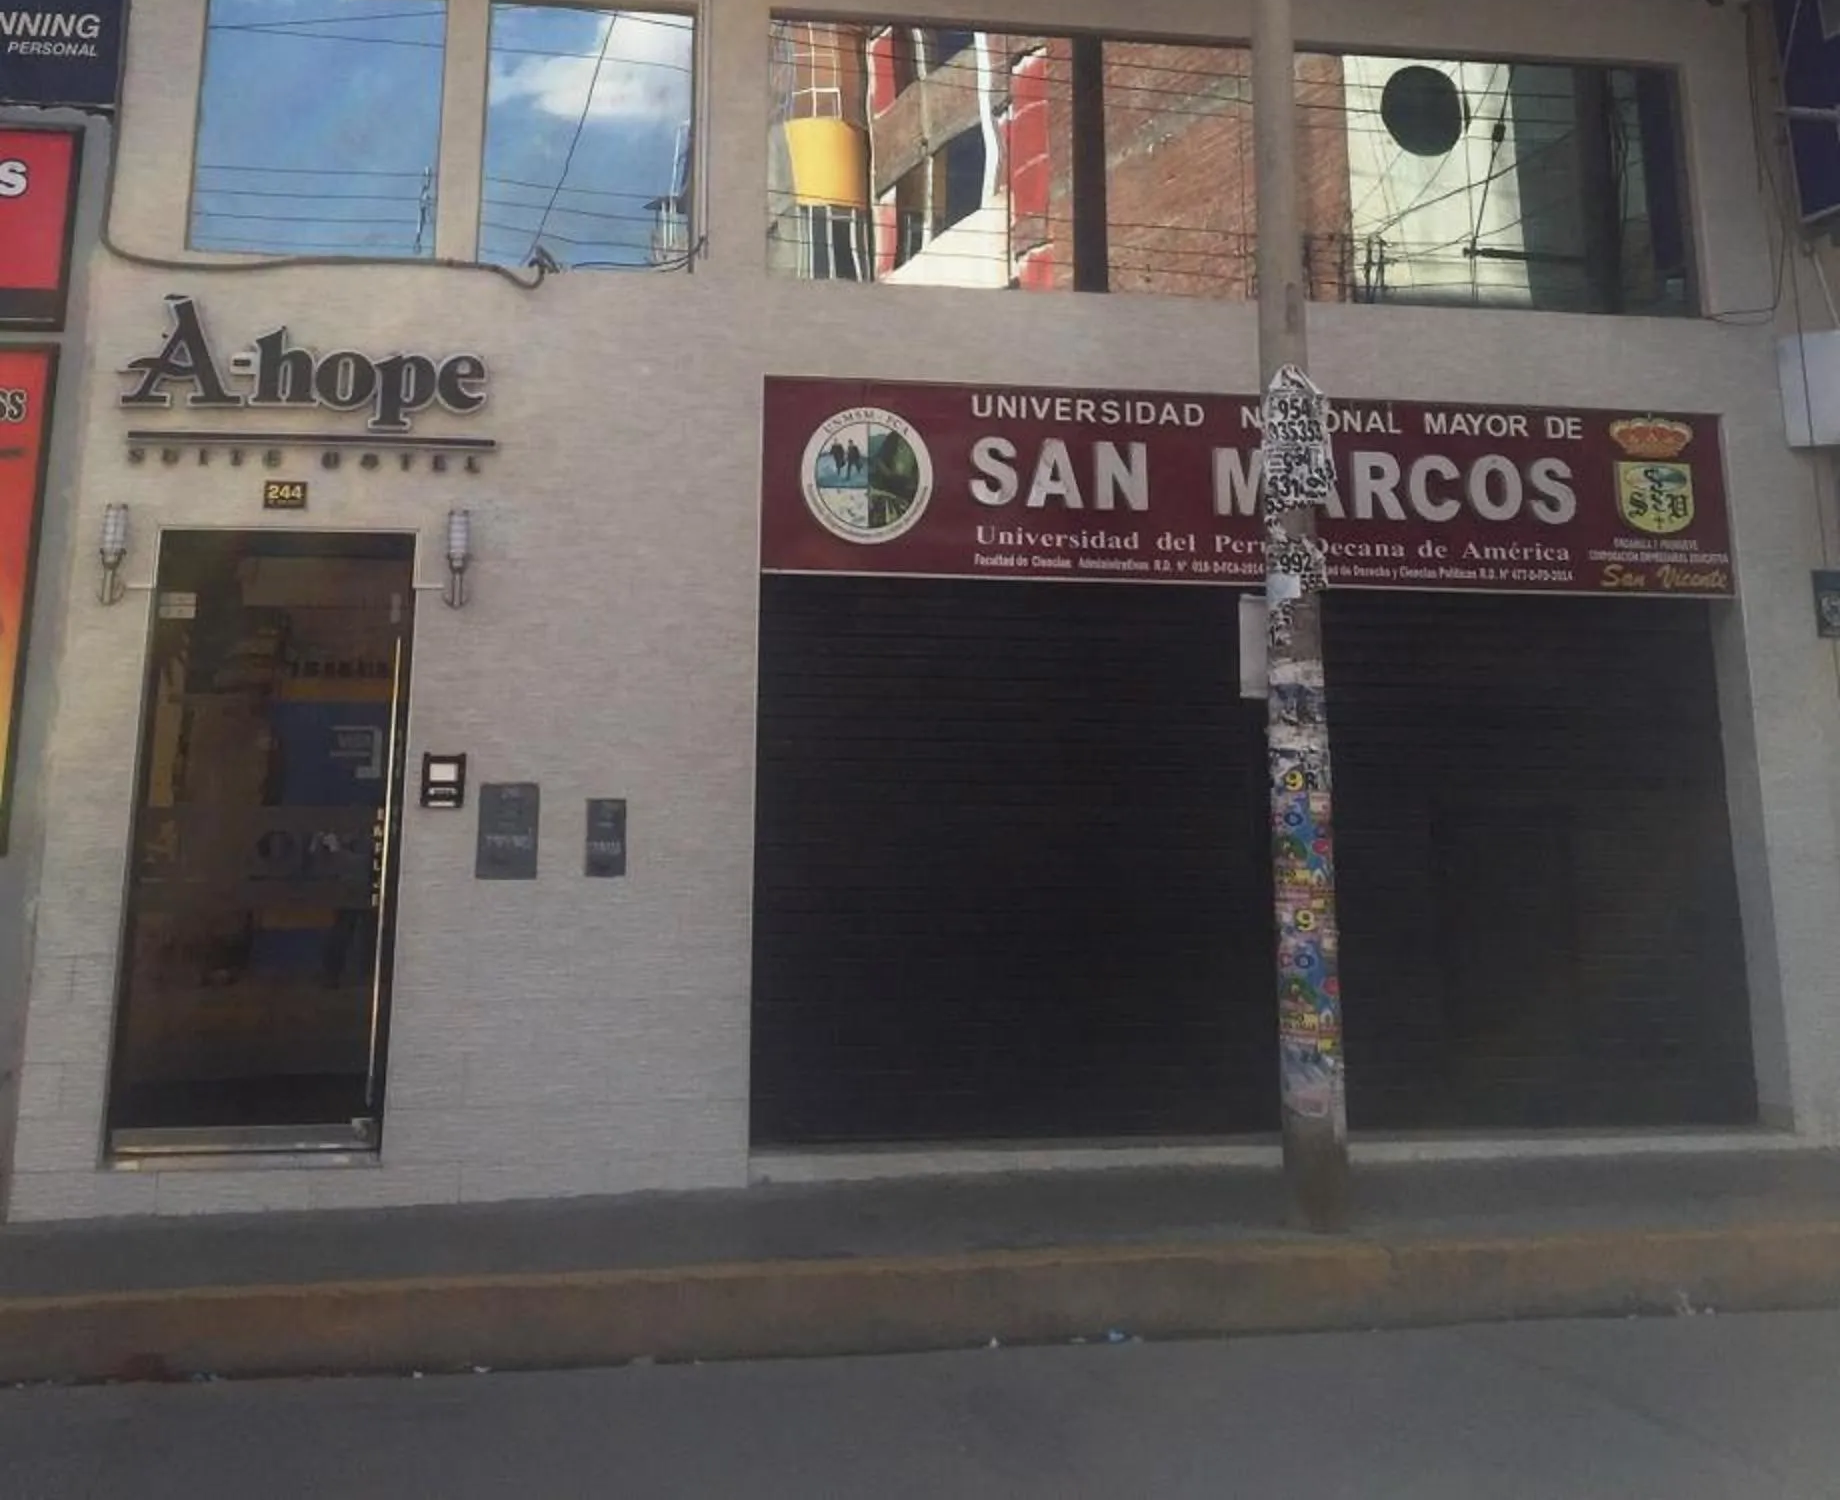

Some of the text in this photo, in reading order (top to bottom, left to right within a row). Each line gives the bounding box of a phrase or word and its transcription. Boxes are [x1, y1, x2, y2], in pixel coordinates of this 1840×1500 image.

[8, 41, 98, 57] PERSONAL
[120, 294, 488, 432] A-hope
[971, 395, 1584, 440] UNIVERSIDAD NONAL MAYOR DE
[269, 484, 303, 499] 244
[968, 437, 1150, 512] SAN
[976, 524, 1139, 550] Universidad
[1156, 531, 1196, 553] del
[1417, 539, 1449, 559] de
[1462, 541, 1570, 561] América
[1600, 562, 1729, 590] San Vicente
